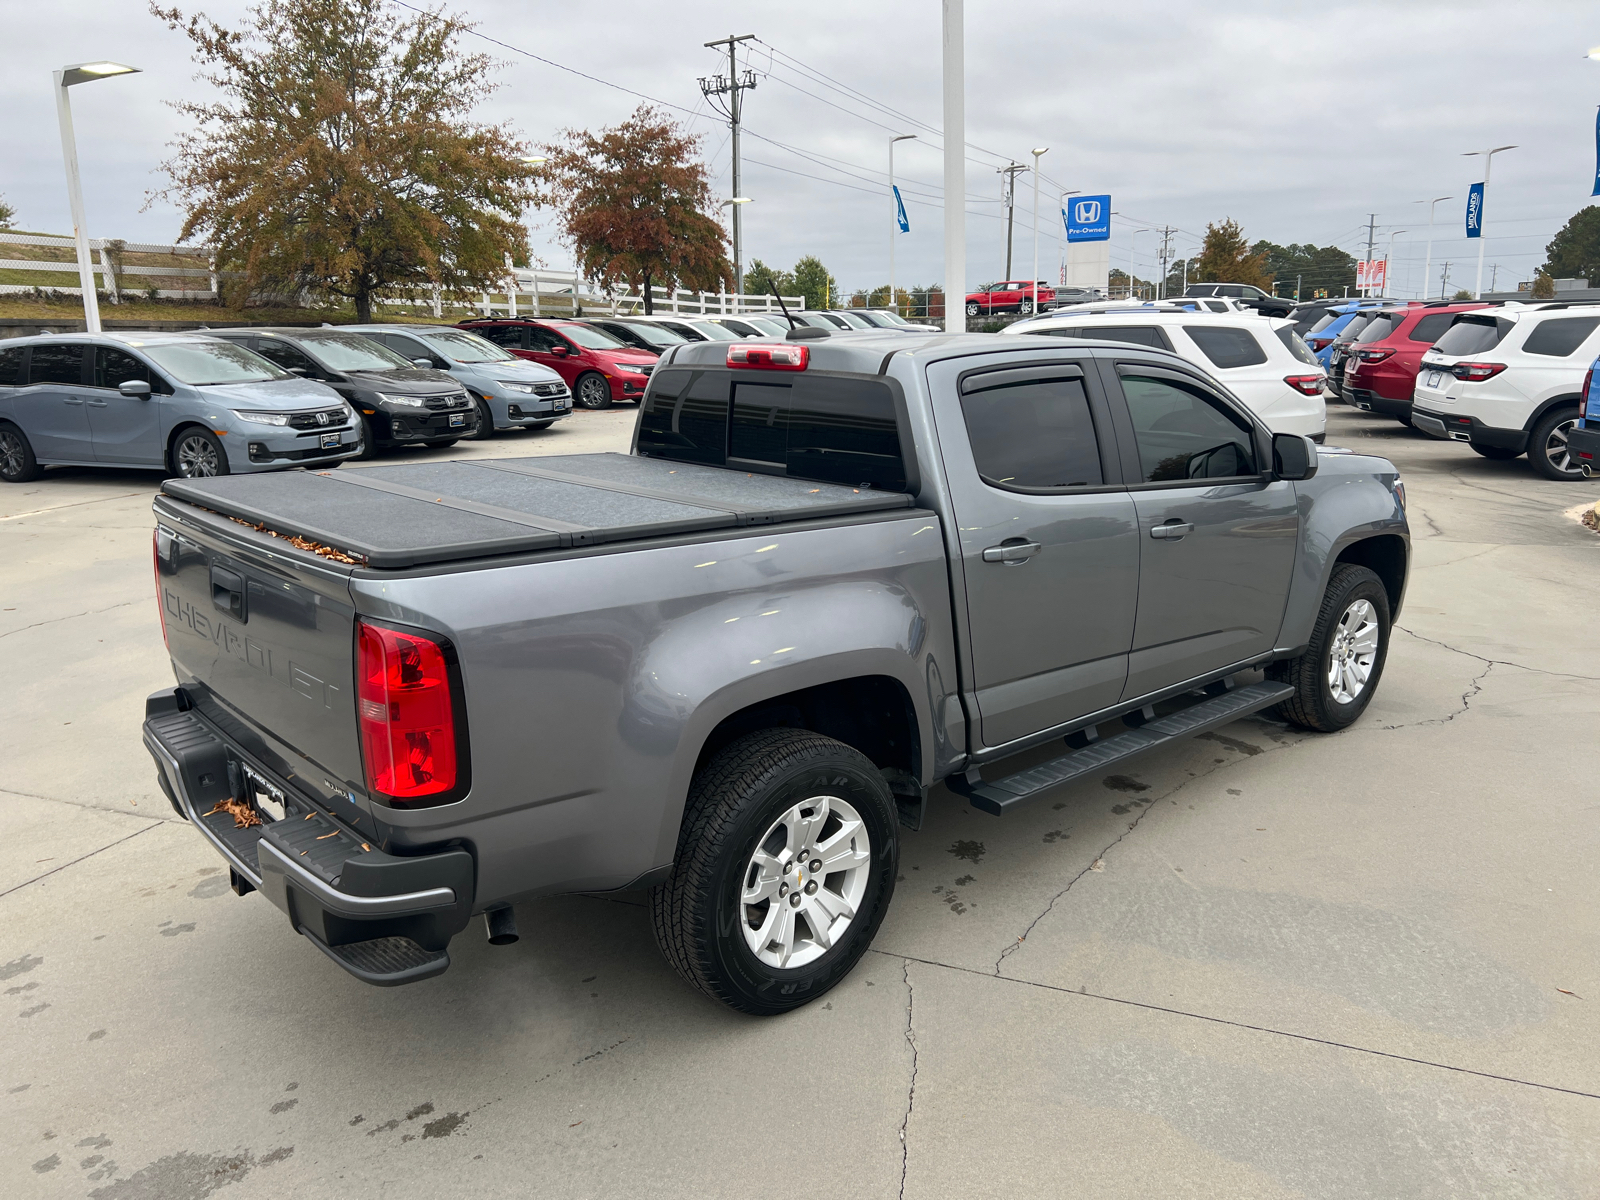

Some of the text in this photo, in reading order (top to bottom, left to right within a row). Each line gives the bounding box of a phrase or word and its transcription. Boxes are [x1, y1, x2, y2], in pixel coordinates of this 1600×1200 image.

[1468, 192, 1477, 229] MIDLANDS
[1069, 226, 1107, 234] Pre-Owned
[163, 587, 340, 709] CHEVROLET
